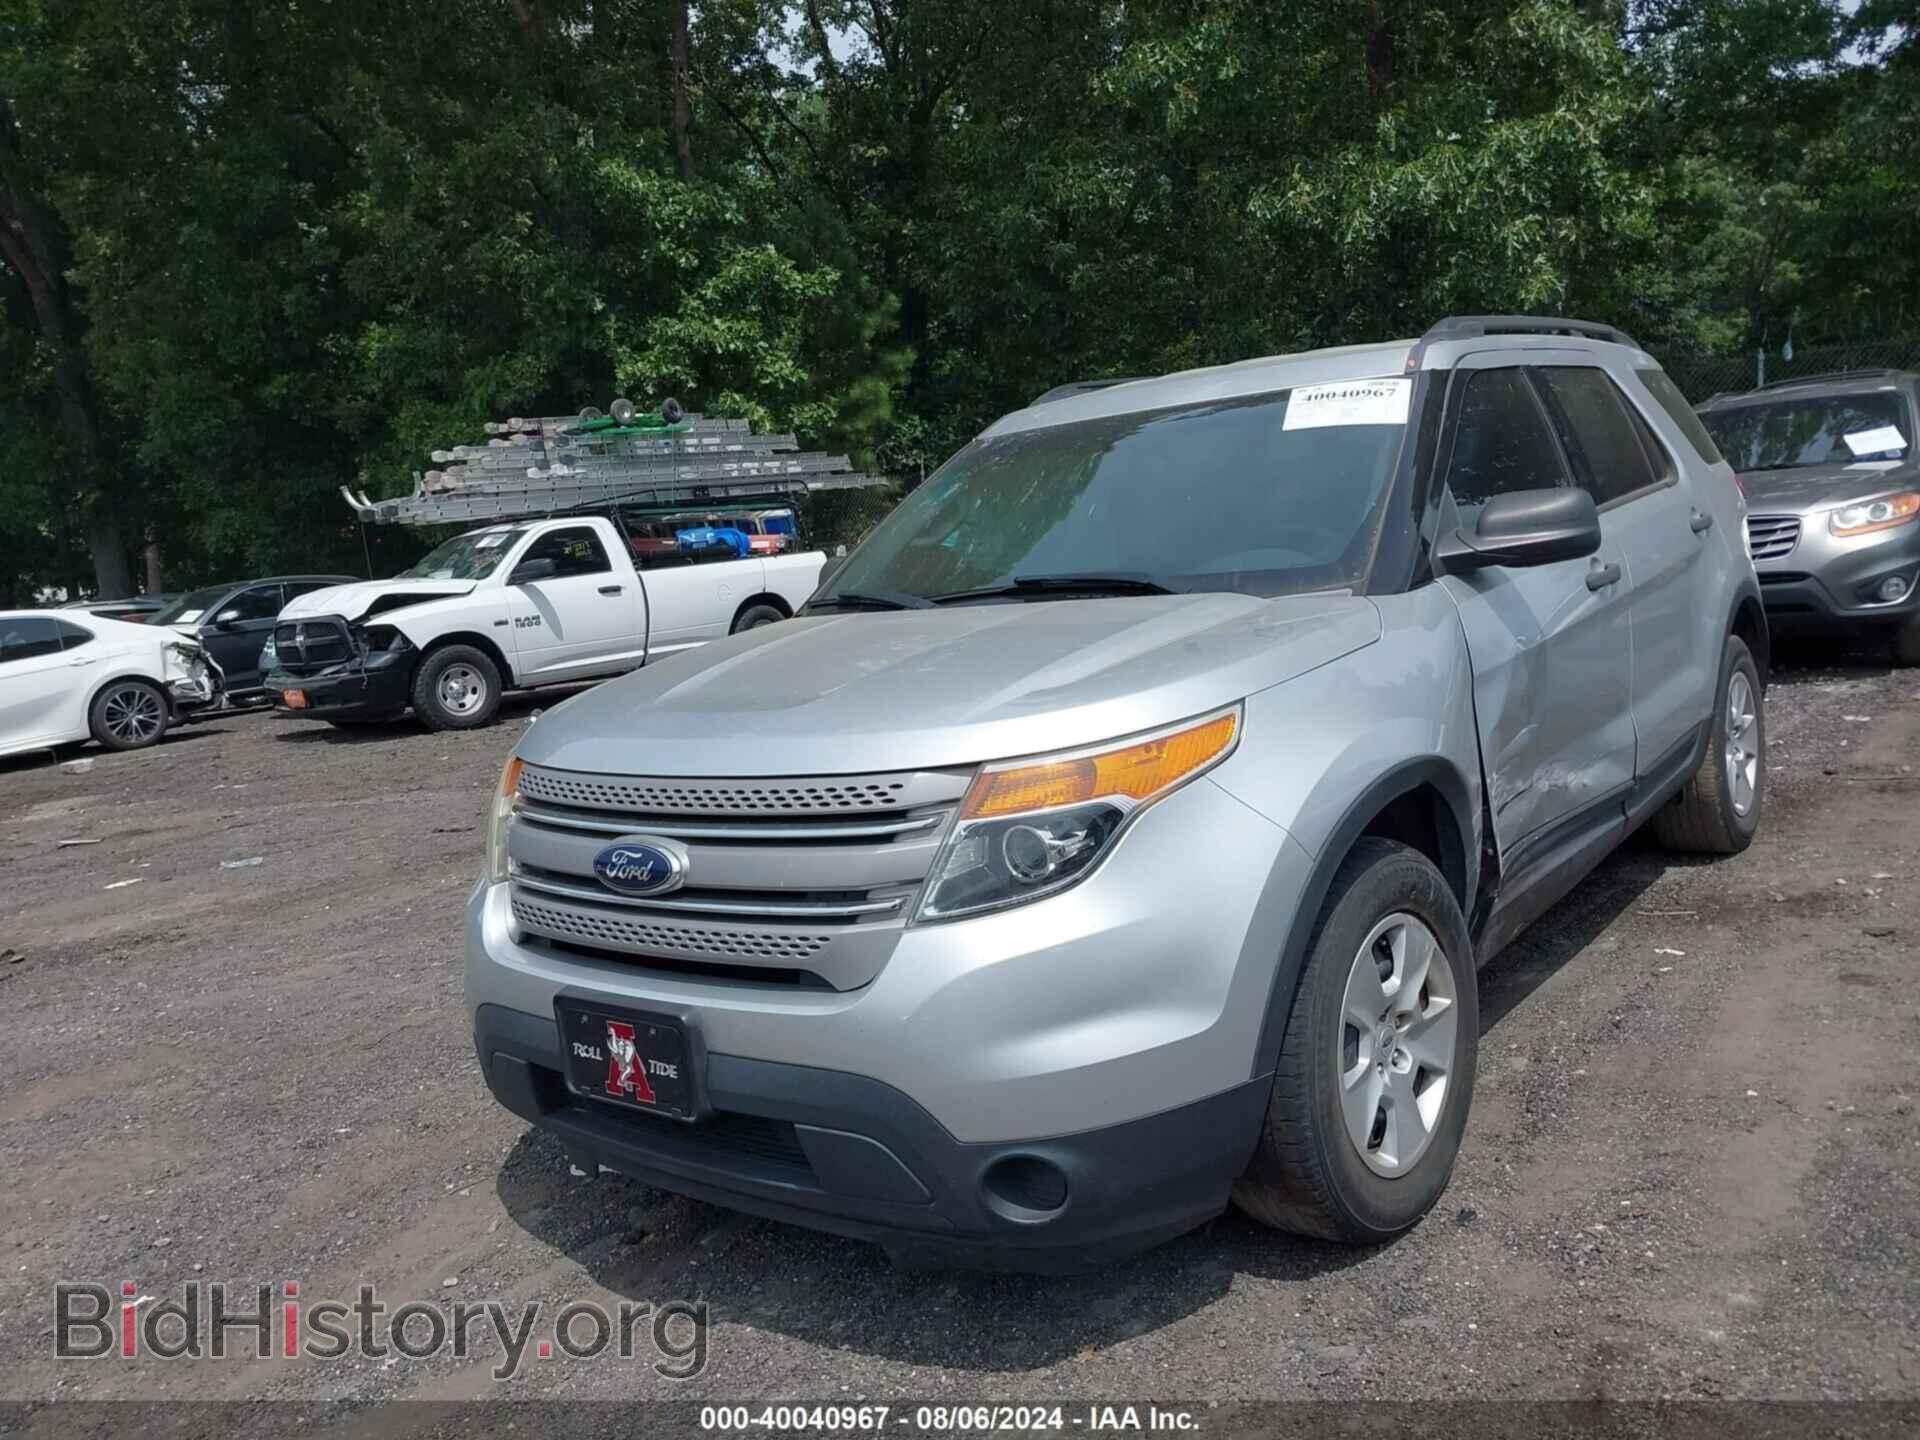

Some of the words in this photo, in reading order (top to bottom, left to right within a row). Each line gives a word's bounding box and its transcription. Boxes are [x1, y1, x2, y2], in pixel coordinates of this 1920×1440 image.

[1302, 388, 1397, 401] 40040967
[606, 849, 654, 882] Ford
[572, 1042, 603, 1061] ROLL
[648, 1059, 679, 1079] TIDE
